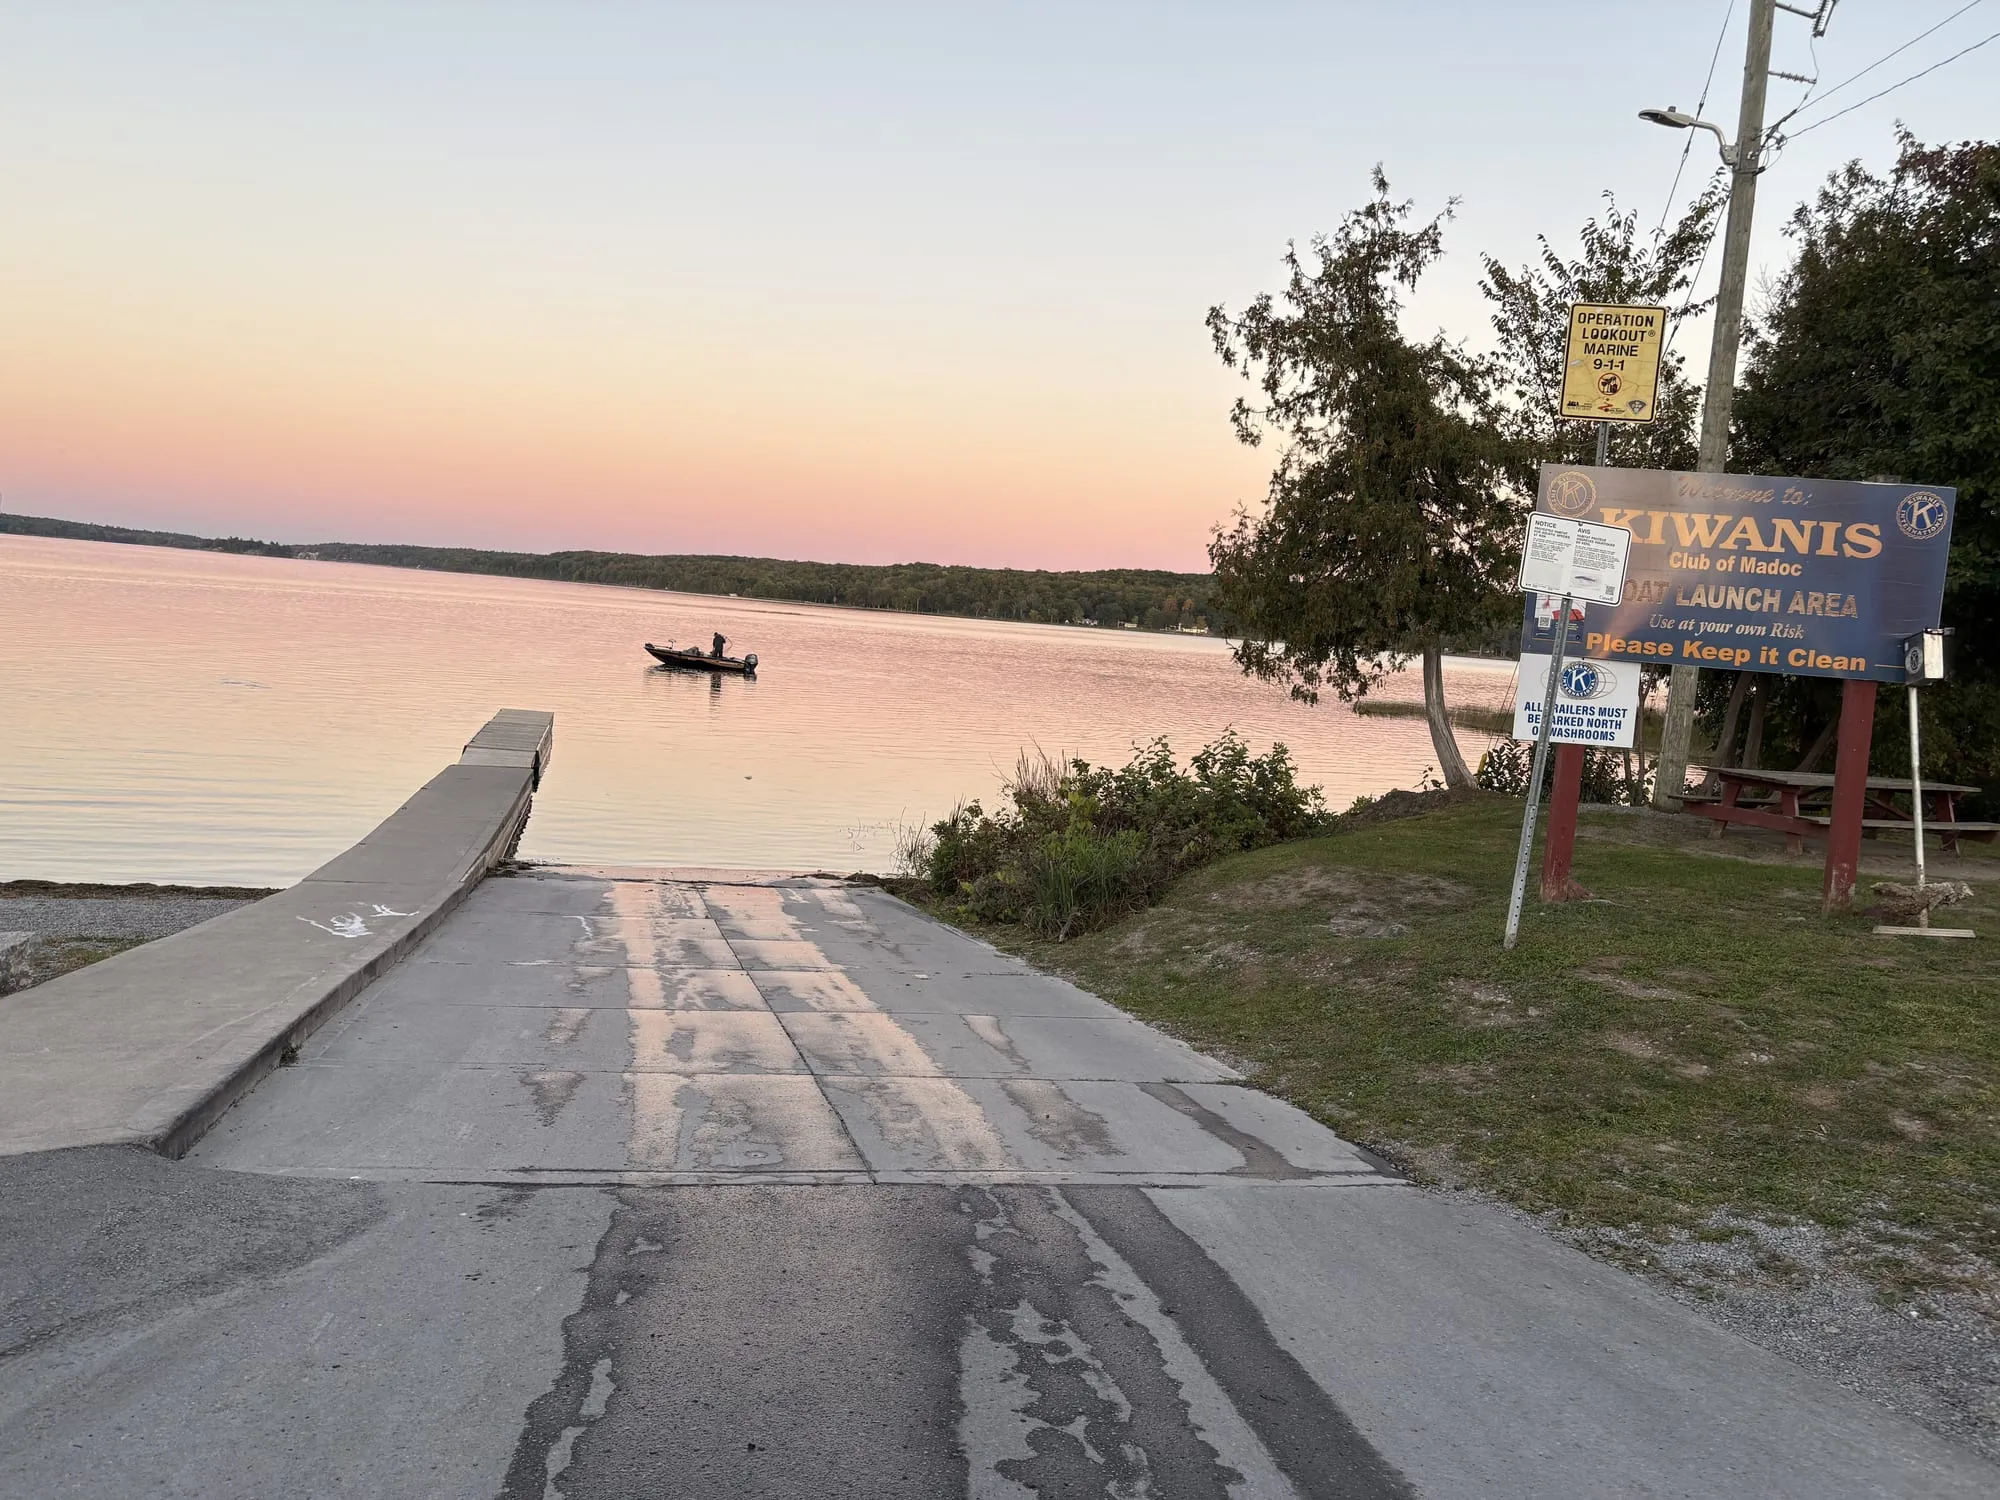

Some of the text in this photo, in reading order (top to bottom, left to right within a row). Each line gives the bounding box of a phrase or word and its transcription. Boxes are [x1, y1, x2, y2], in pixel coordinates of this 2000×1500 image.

[1577, 312, 1654, 327] OPERATION
[1584, 343, 1639, 356] MARINE
[1593, 359, 1625, 370] 9-1-1
[1907, 495, 1940, 507] KIWANIS
[1900, 509, 1944, 536] INTERNATIONAL
[1911, 501, 1934, 529] K
[1535, 520, 1557, 528] NOTICE
[1577, 527, 1591, 535] AVIS
[1600, 507, 1883, 559] KIWANIS
[1669, 551, 1802, 577] Club of Madoc
[1623, 578, 1859, 619] OAT LAUNCH AREA
[1650, 614, 1805, 639] Use at your own Risk
[1586, 632, 1866, 672] Please Keep it Clean
[1571, 670, 1588, 691] K
[1524, 702, 1628, 718] ALL RAILERS MUST
[1527, 714, 1622, 730] BE ARKED NORTH
[1532, 726, 1539, 736] O
